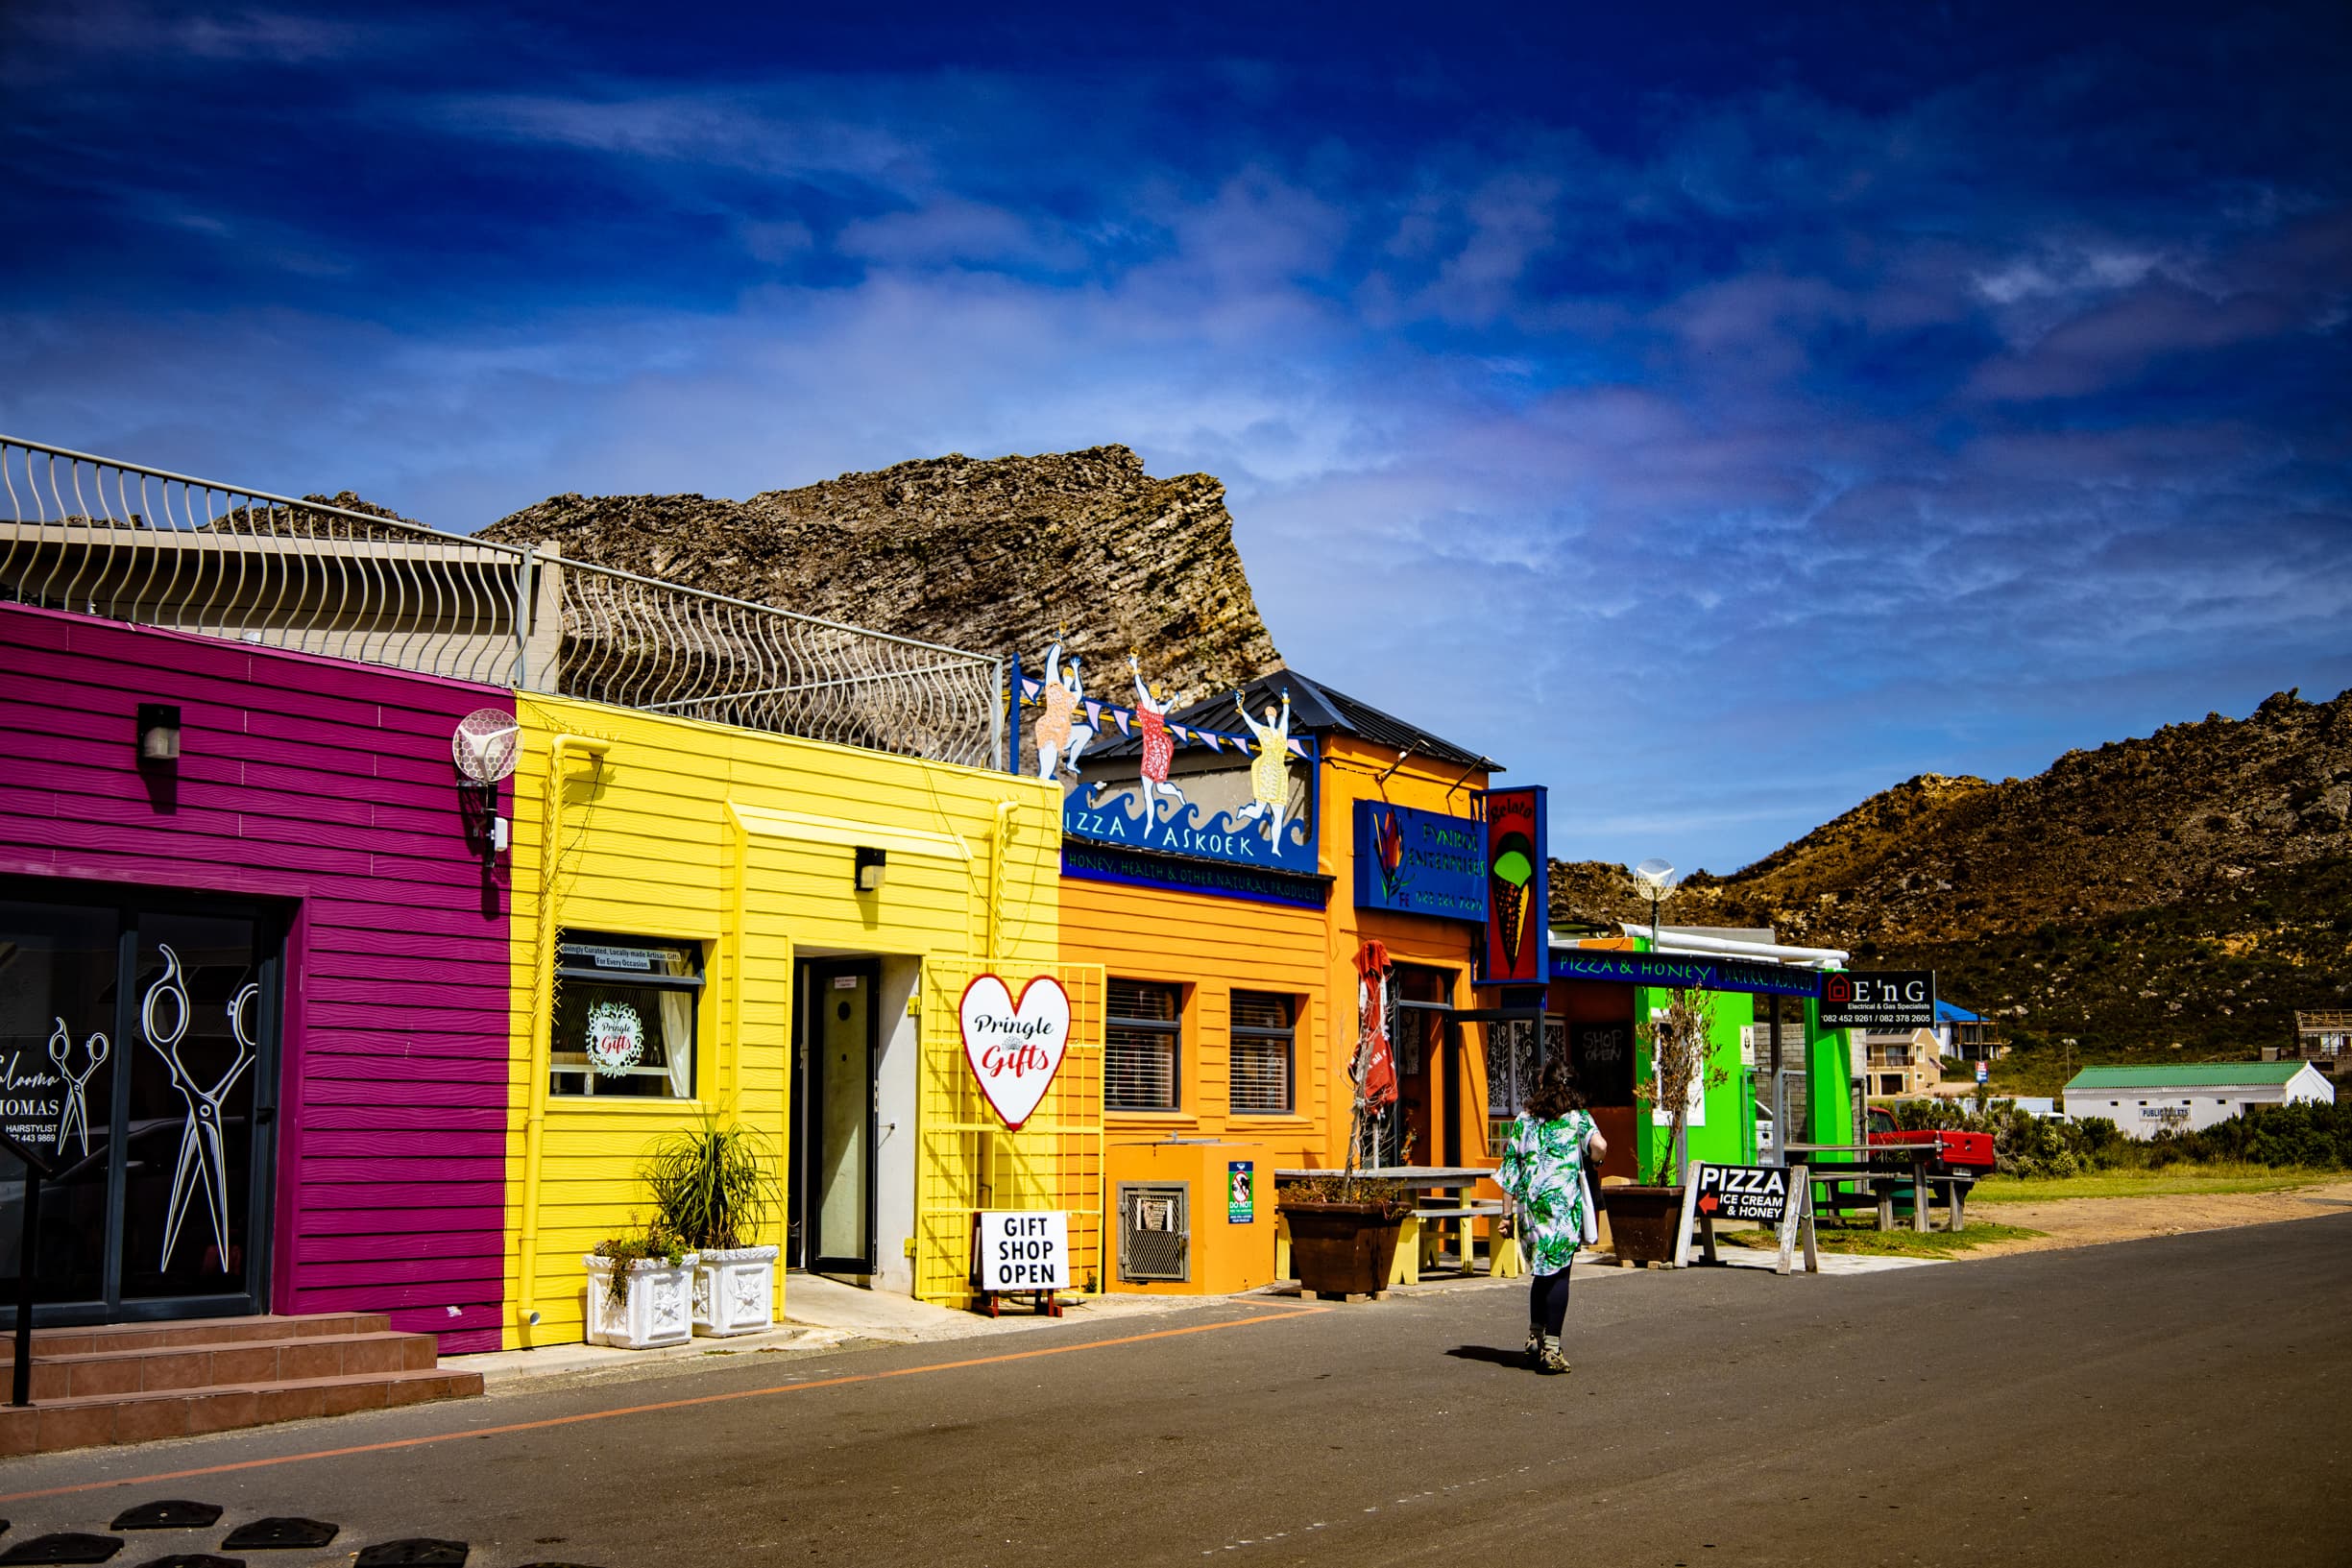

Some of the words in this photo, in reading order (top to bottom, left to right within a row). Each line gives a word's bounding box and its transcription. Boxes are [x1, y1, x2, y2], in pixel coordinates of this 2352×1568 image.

[1065, 812, 1126, 838] IZZA
[1162, 827, 1254, 856] ASKOEK
[1408, 848, 1487, 878] ENTERPRISES
[1121, 860, 1164, 878] HEALTH
[1167, 867, 1176, 881] &
[1180, 869, 1214, 886] OTHER
[1216, 873, 1269, 894] NATURAL
[562, 945, 583, 954] ovingly
[607, 958, 620, 967] Every
[1560, 956, 1612, 974] PIZZA
[1619, 959, 1634, 975] &
[1641, 961, 1711, 980] HONEY
[1897, 1002, 1930, 1011] Specialists
[601, 1023, 631, 1035] Pringle
[974, 1014, 1054, 1040] Pringle
[601, 1035, 631, 1054] Gifts
[1583, 1029, 1623, 1049] SHOP
[982, 1044, 1051, 1078] Gifts
[1585, 1048, 1622, 1061] OPEN
[6, 1124, 58, 1133] HAIRSTYLIST
[1701, 1168, 1785, 1195] PIZZA
[1719, 1194, 1738, 1204] ICE
[1741, 1195, 1784, 1207] CREAM
[1727, 1205, 1735, 1217] &
[1739, 1206, 1782, 1218] HONEY
[1004, 1218, 1048, 1238] GIFT
[999, 1241, 1055, 1261] SHOP
[999, 1264, 1055, 1285] OPEN
